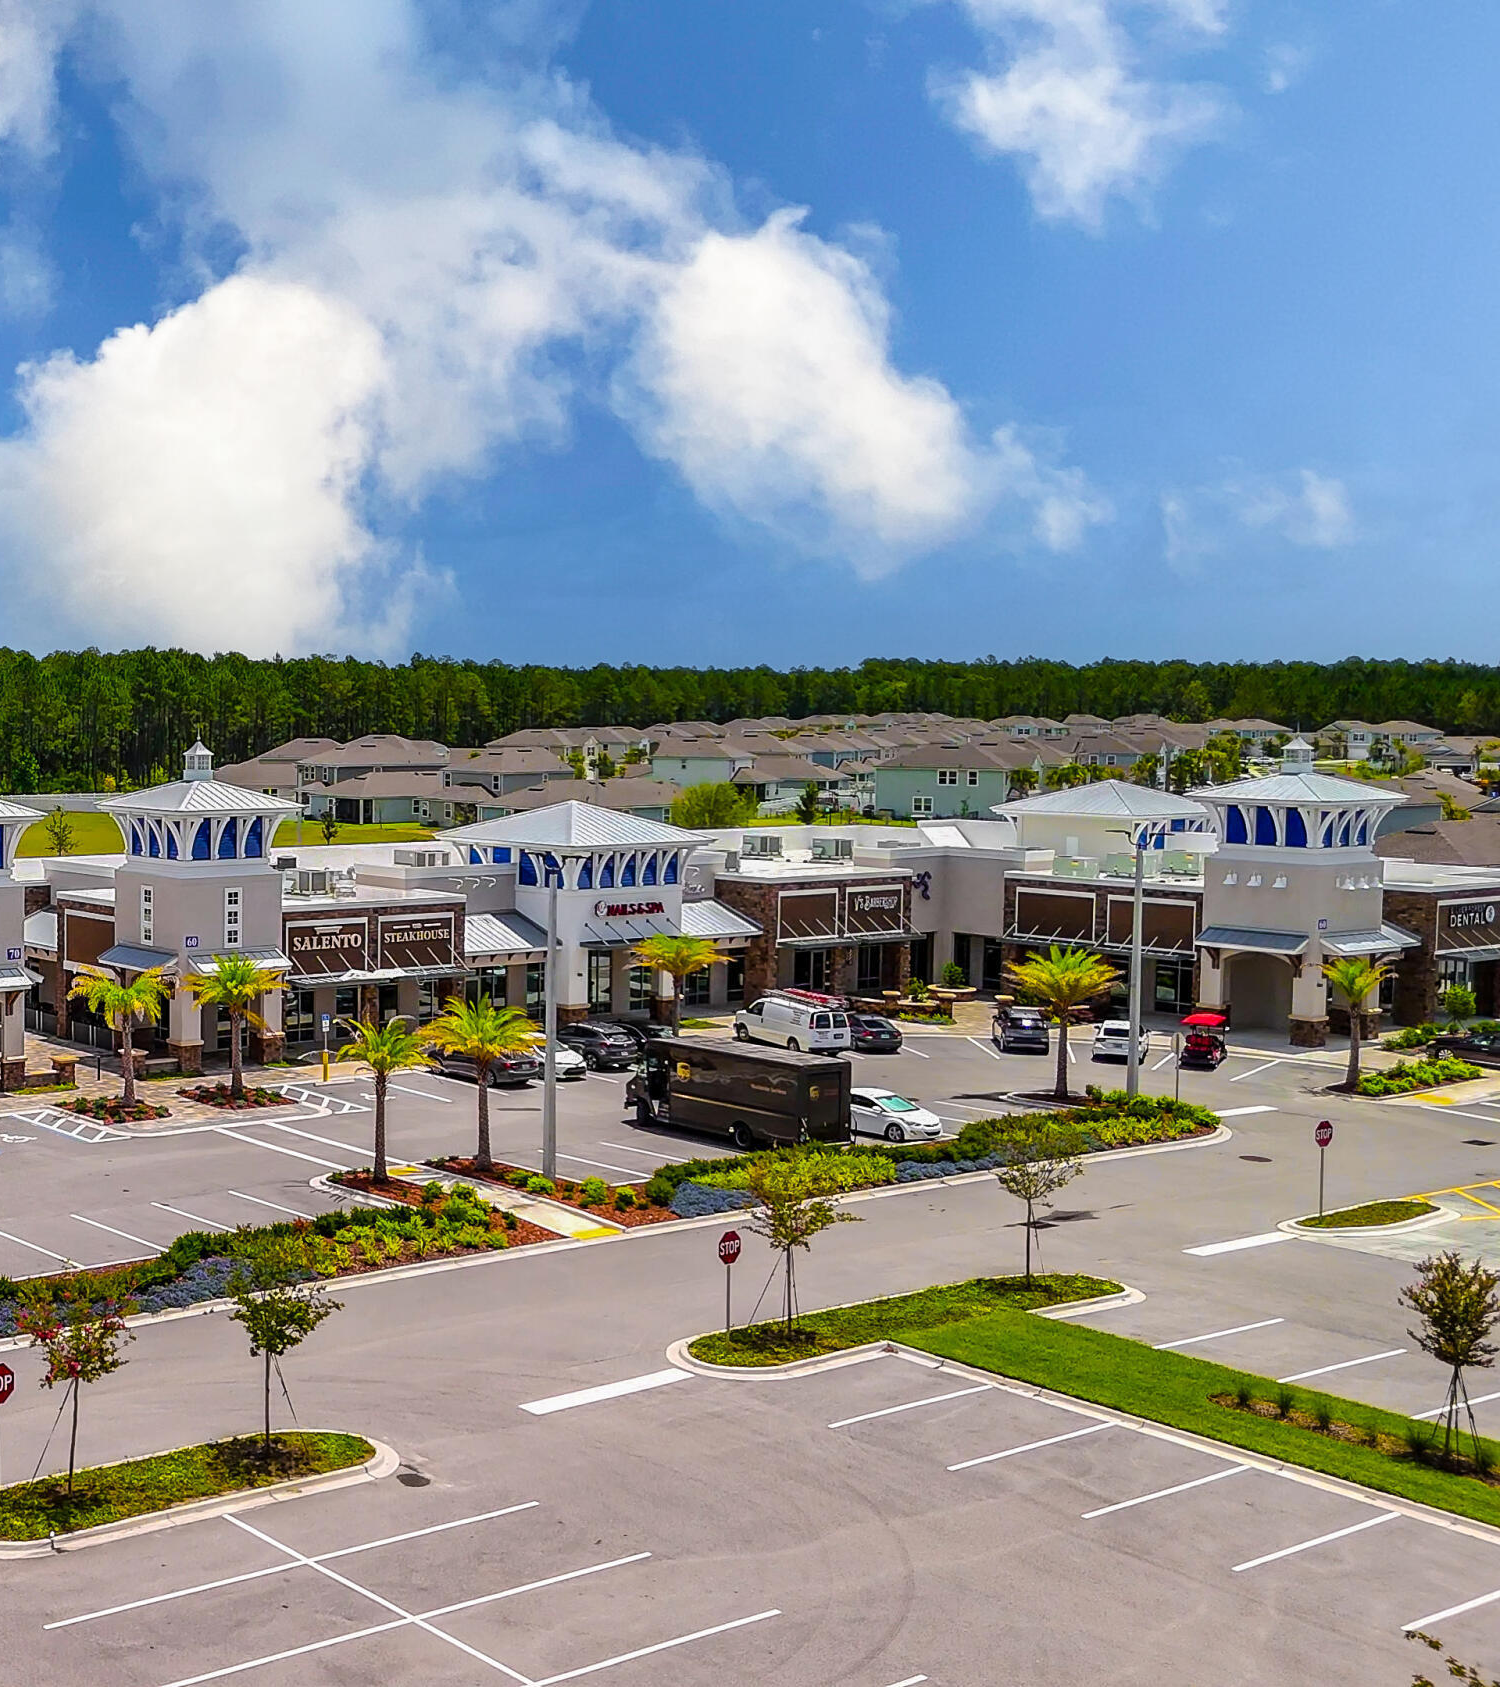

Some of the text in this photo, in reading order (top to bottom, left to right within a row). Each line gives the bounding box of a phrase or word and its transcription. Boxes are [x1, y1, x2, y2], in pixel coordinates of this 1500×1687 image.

[1450, 912, 1486, 927] DENTAL
[187, 937, 198, 947] 60
[293, 933, 362, 951] SALENTO
[384, 929, 450, 943] STEAKHOUSE
[9, 949, 20, 960] 70
[1315, 1127, 1333, 1140] STOP
[720, 1239, 741, 1256] STOP
